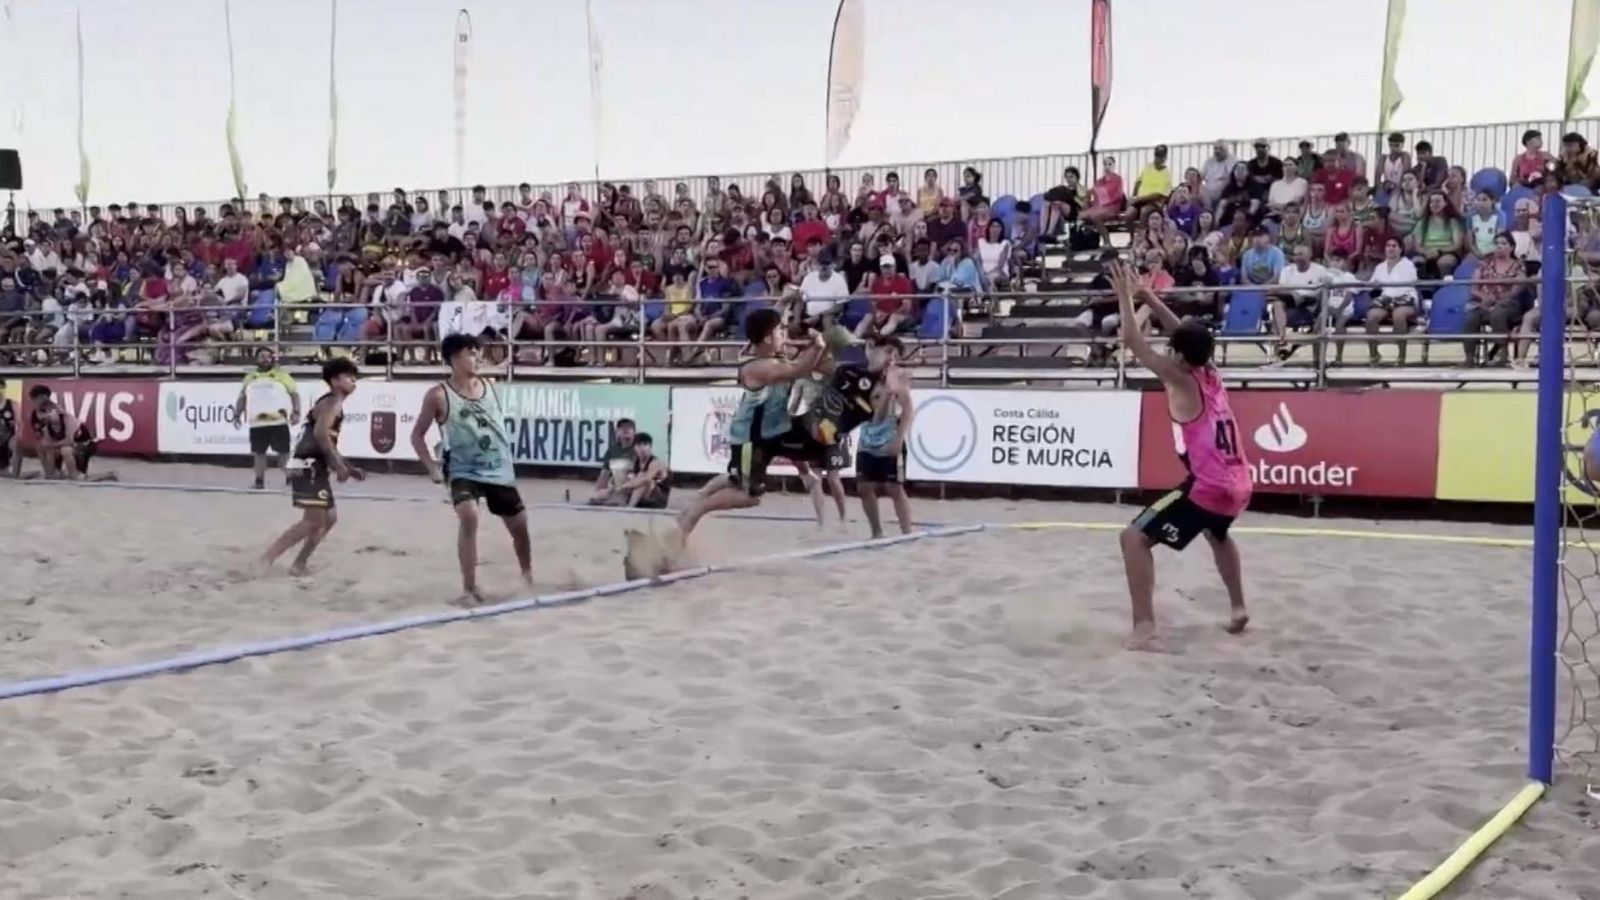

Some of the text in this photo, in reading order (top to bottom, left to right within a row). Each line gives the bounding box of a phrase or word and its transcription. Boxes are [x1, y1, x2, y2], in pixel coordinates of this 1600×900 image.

[521, 387, 582, 417] MANGA
[993, 408, 1060, 419] Costa Cálida
[50, 391, 135, 442] VIS
[992, 422, 1075, 444] REGIÓN
[991, 447, 1113, 468] DE MURCIA
[1250, 458, 1359, 486] ntander
